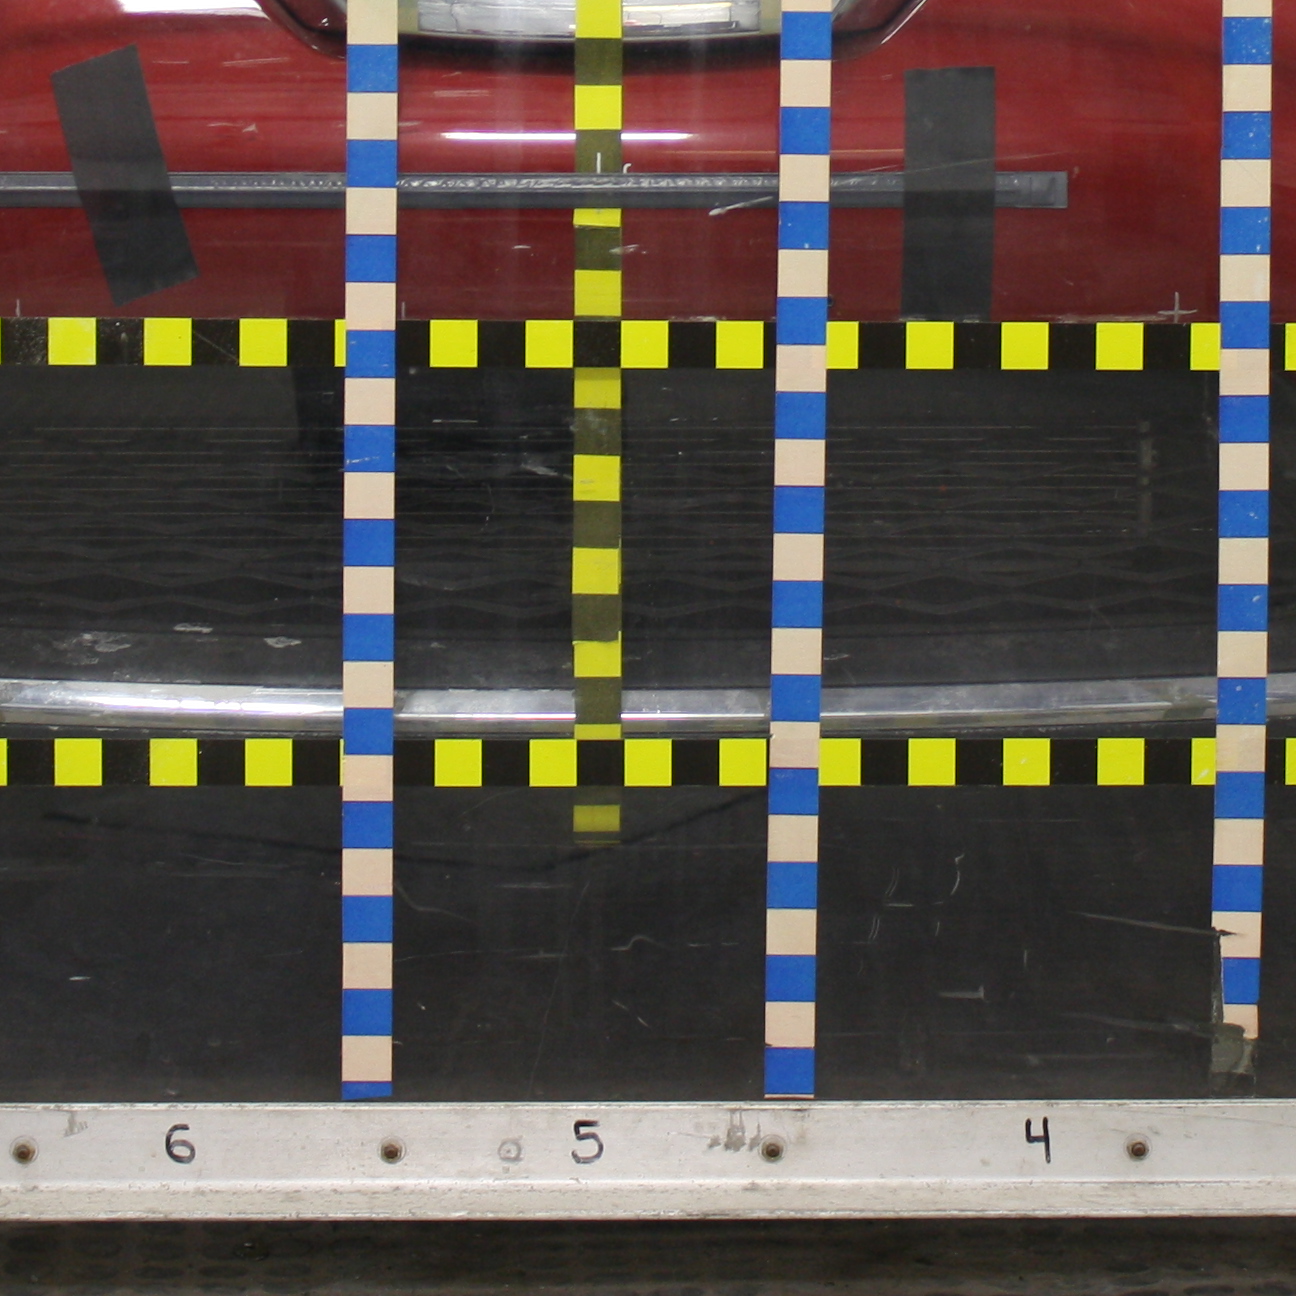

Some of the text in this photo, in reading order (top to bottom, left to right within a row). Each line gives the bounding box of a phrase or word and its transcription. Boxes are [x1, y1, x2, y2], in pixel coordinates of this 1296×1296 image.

[164, 1123, 196, 1164] 6
[571, 1119, 604, 1164] 5
[1024, 1116, 1051, 1164] 4
